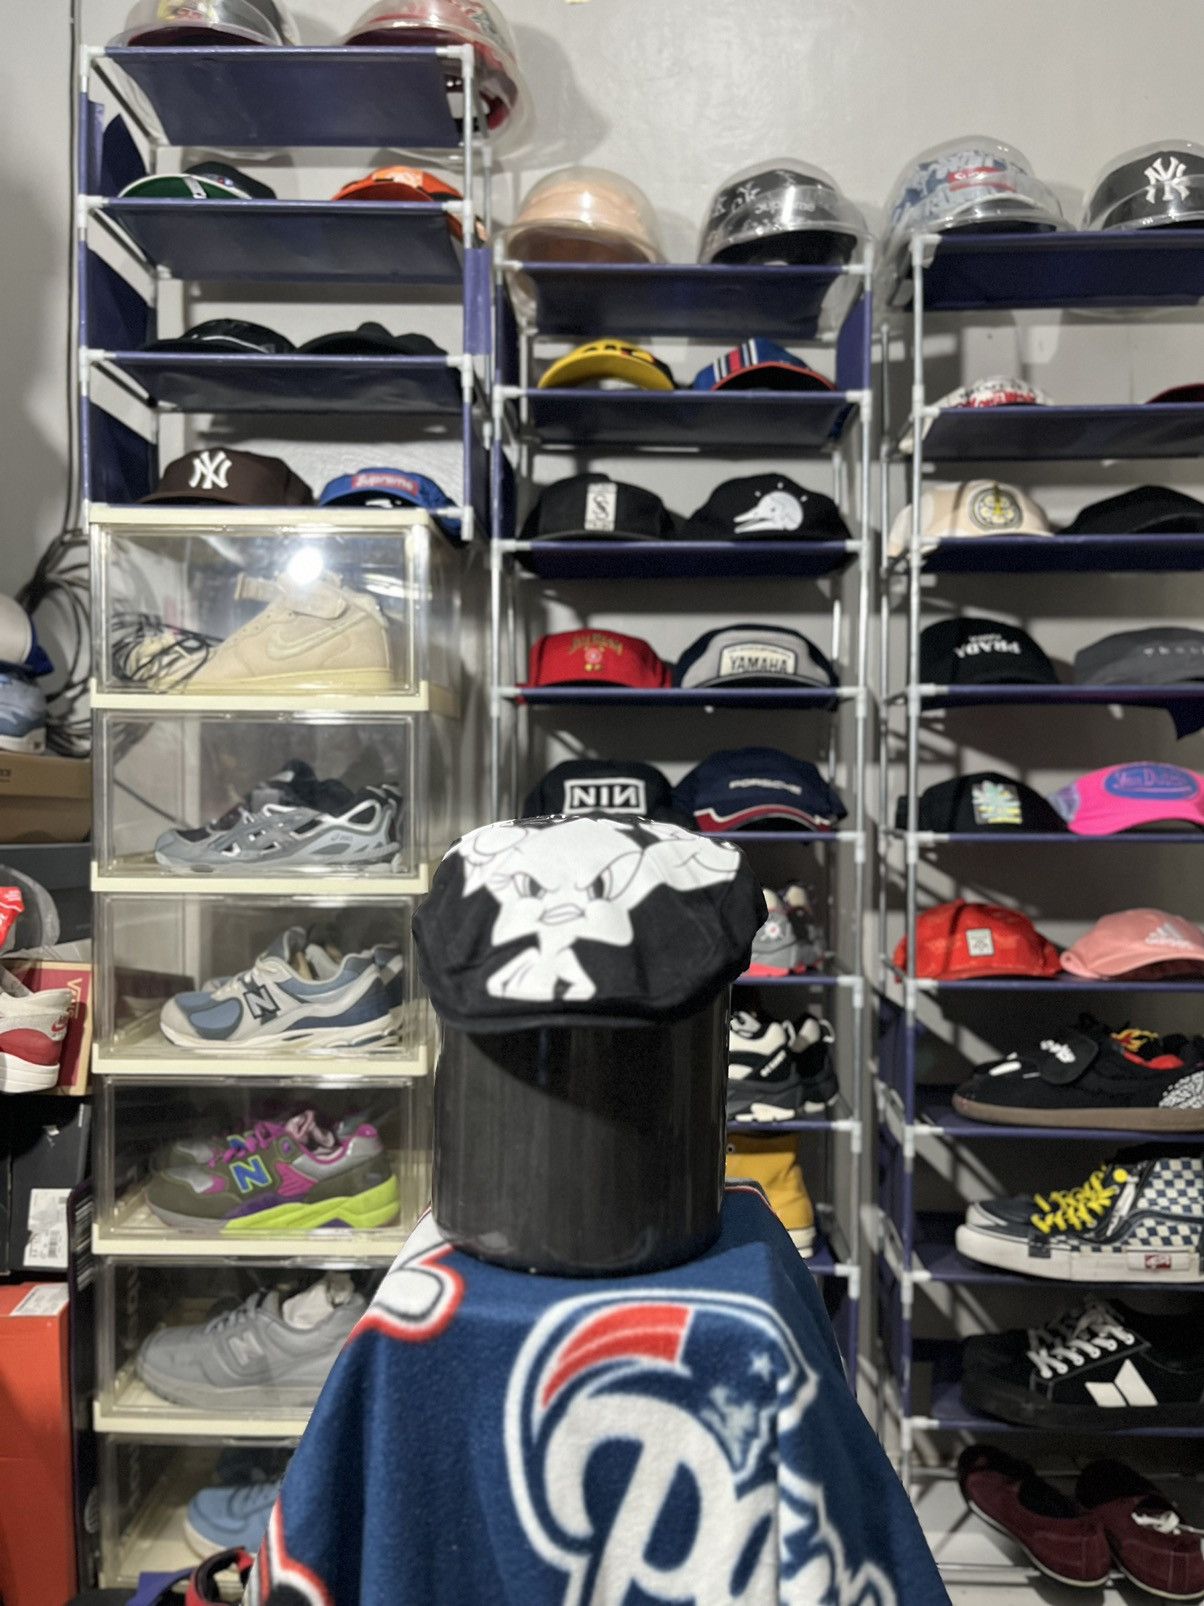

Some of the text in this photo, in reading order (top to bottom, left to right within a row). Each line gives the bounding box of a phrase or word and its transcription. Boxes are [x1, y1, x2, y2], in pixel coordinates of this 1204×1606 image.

[1143, 156, 1190, 204] NY
[189, 450, 232, 489] NY
[730, 655, 788, 675] YAMAHA
[572, 784, 638, 808] NIN
[243, 984, 281, 1020] N
[229, 1155, 272, 1194] N
